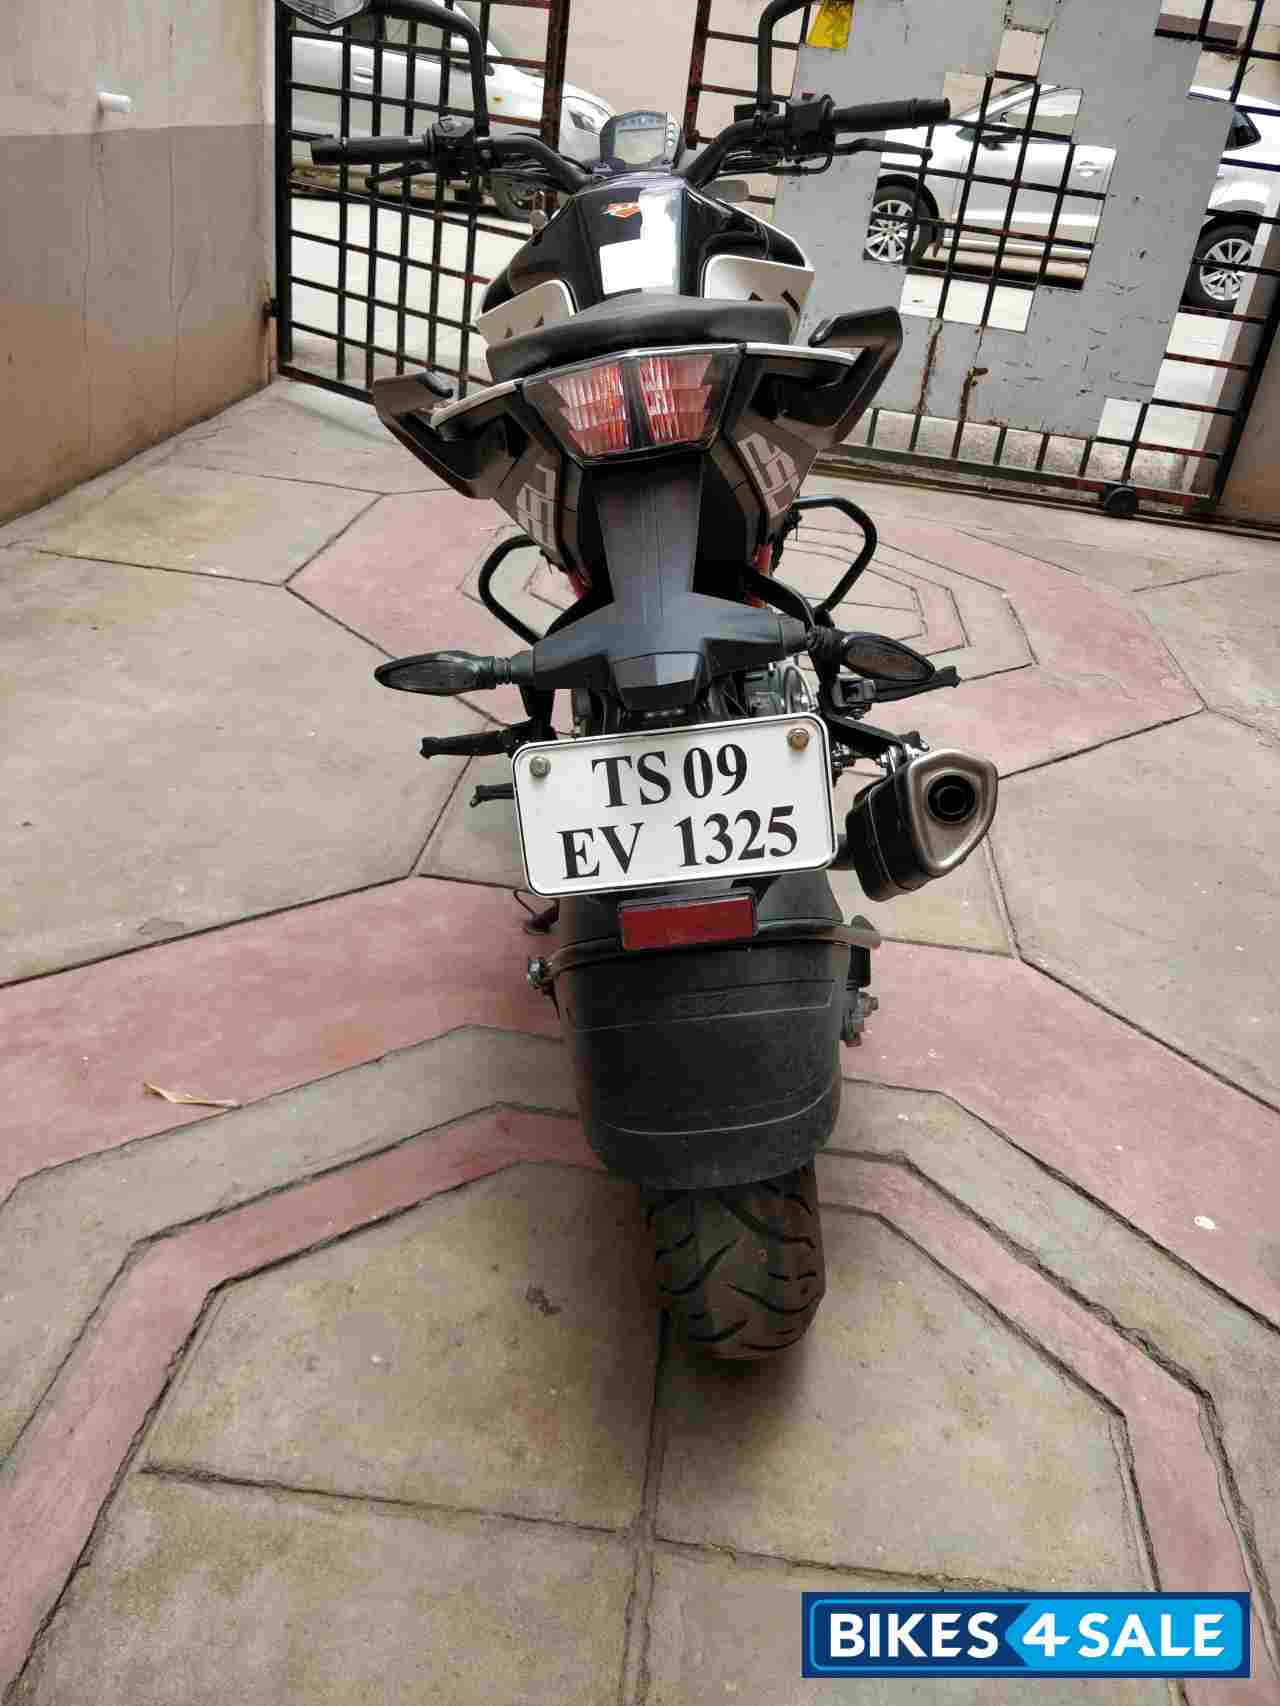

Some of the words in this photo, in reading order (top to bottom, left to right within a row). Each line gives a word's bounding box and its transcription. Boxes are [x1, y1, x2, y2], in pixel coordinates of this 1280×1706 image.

[592, 750, 671, 807] TS
[684, 743, 748, 798] 09
[557, 822, 644, 880] EV
[675, 805, 798, 867] 1325
